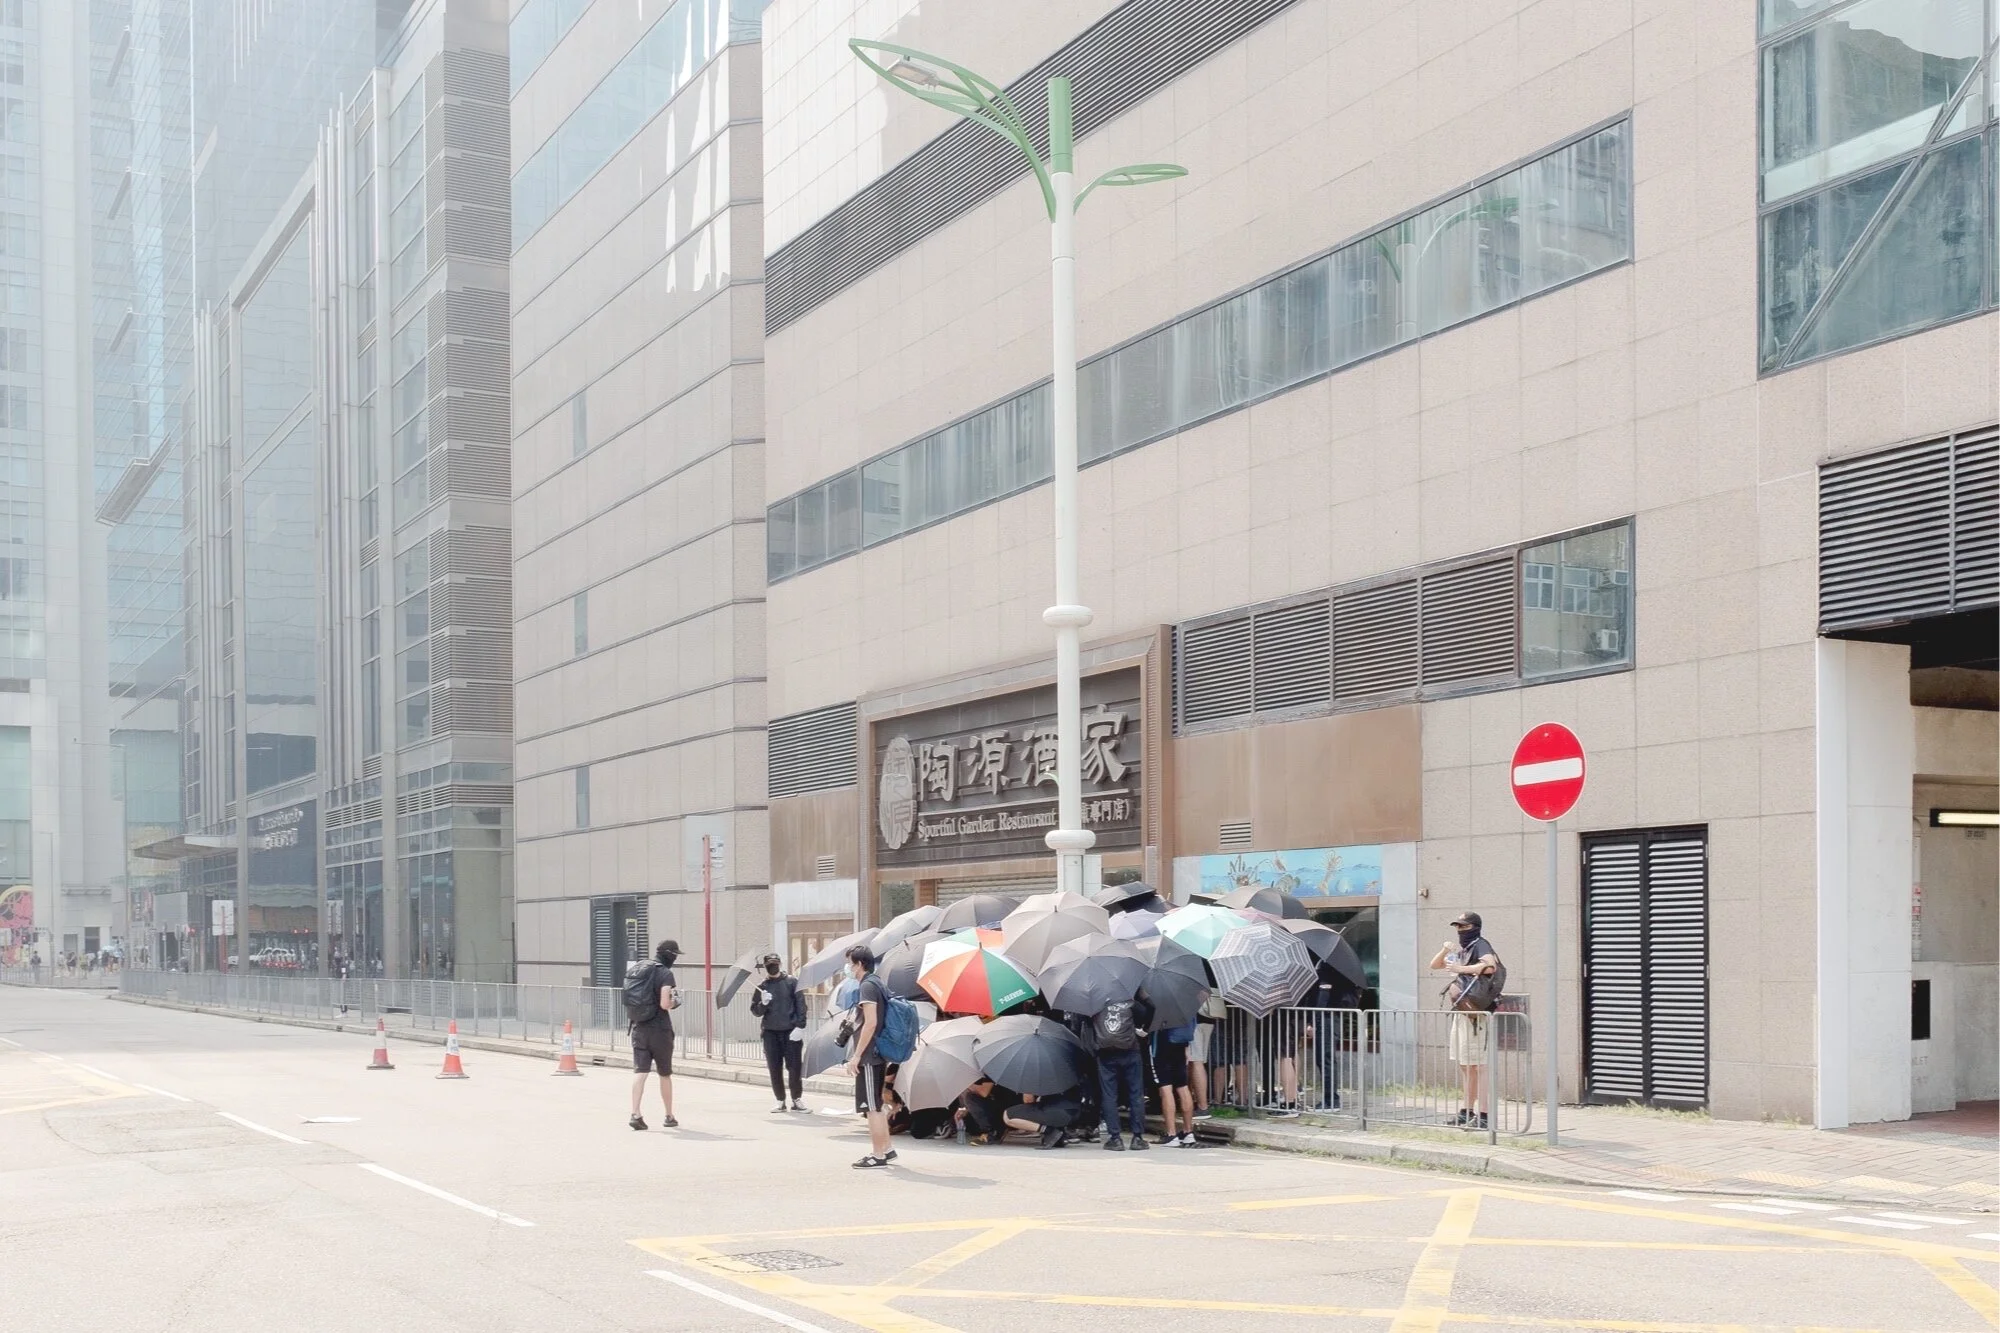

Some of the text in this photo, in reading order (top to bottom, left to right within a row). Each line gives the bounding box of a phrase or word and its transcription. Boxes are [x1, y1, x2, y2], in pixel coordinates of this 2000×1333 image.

[919, 703, 1130, 802] 陶源酒家
[918, 808, 1057, 841] Sportful Garden Restaurant
